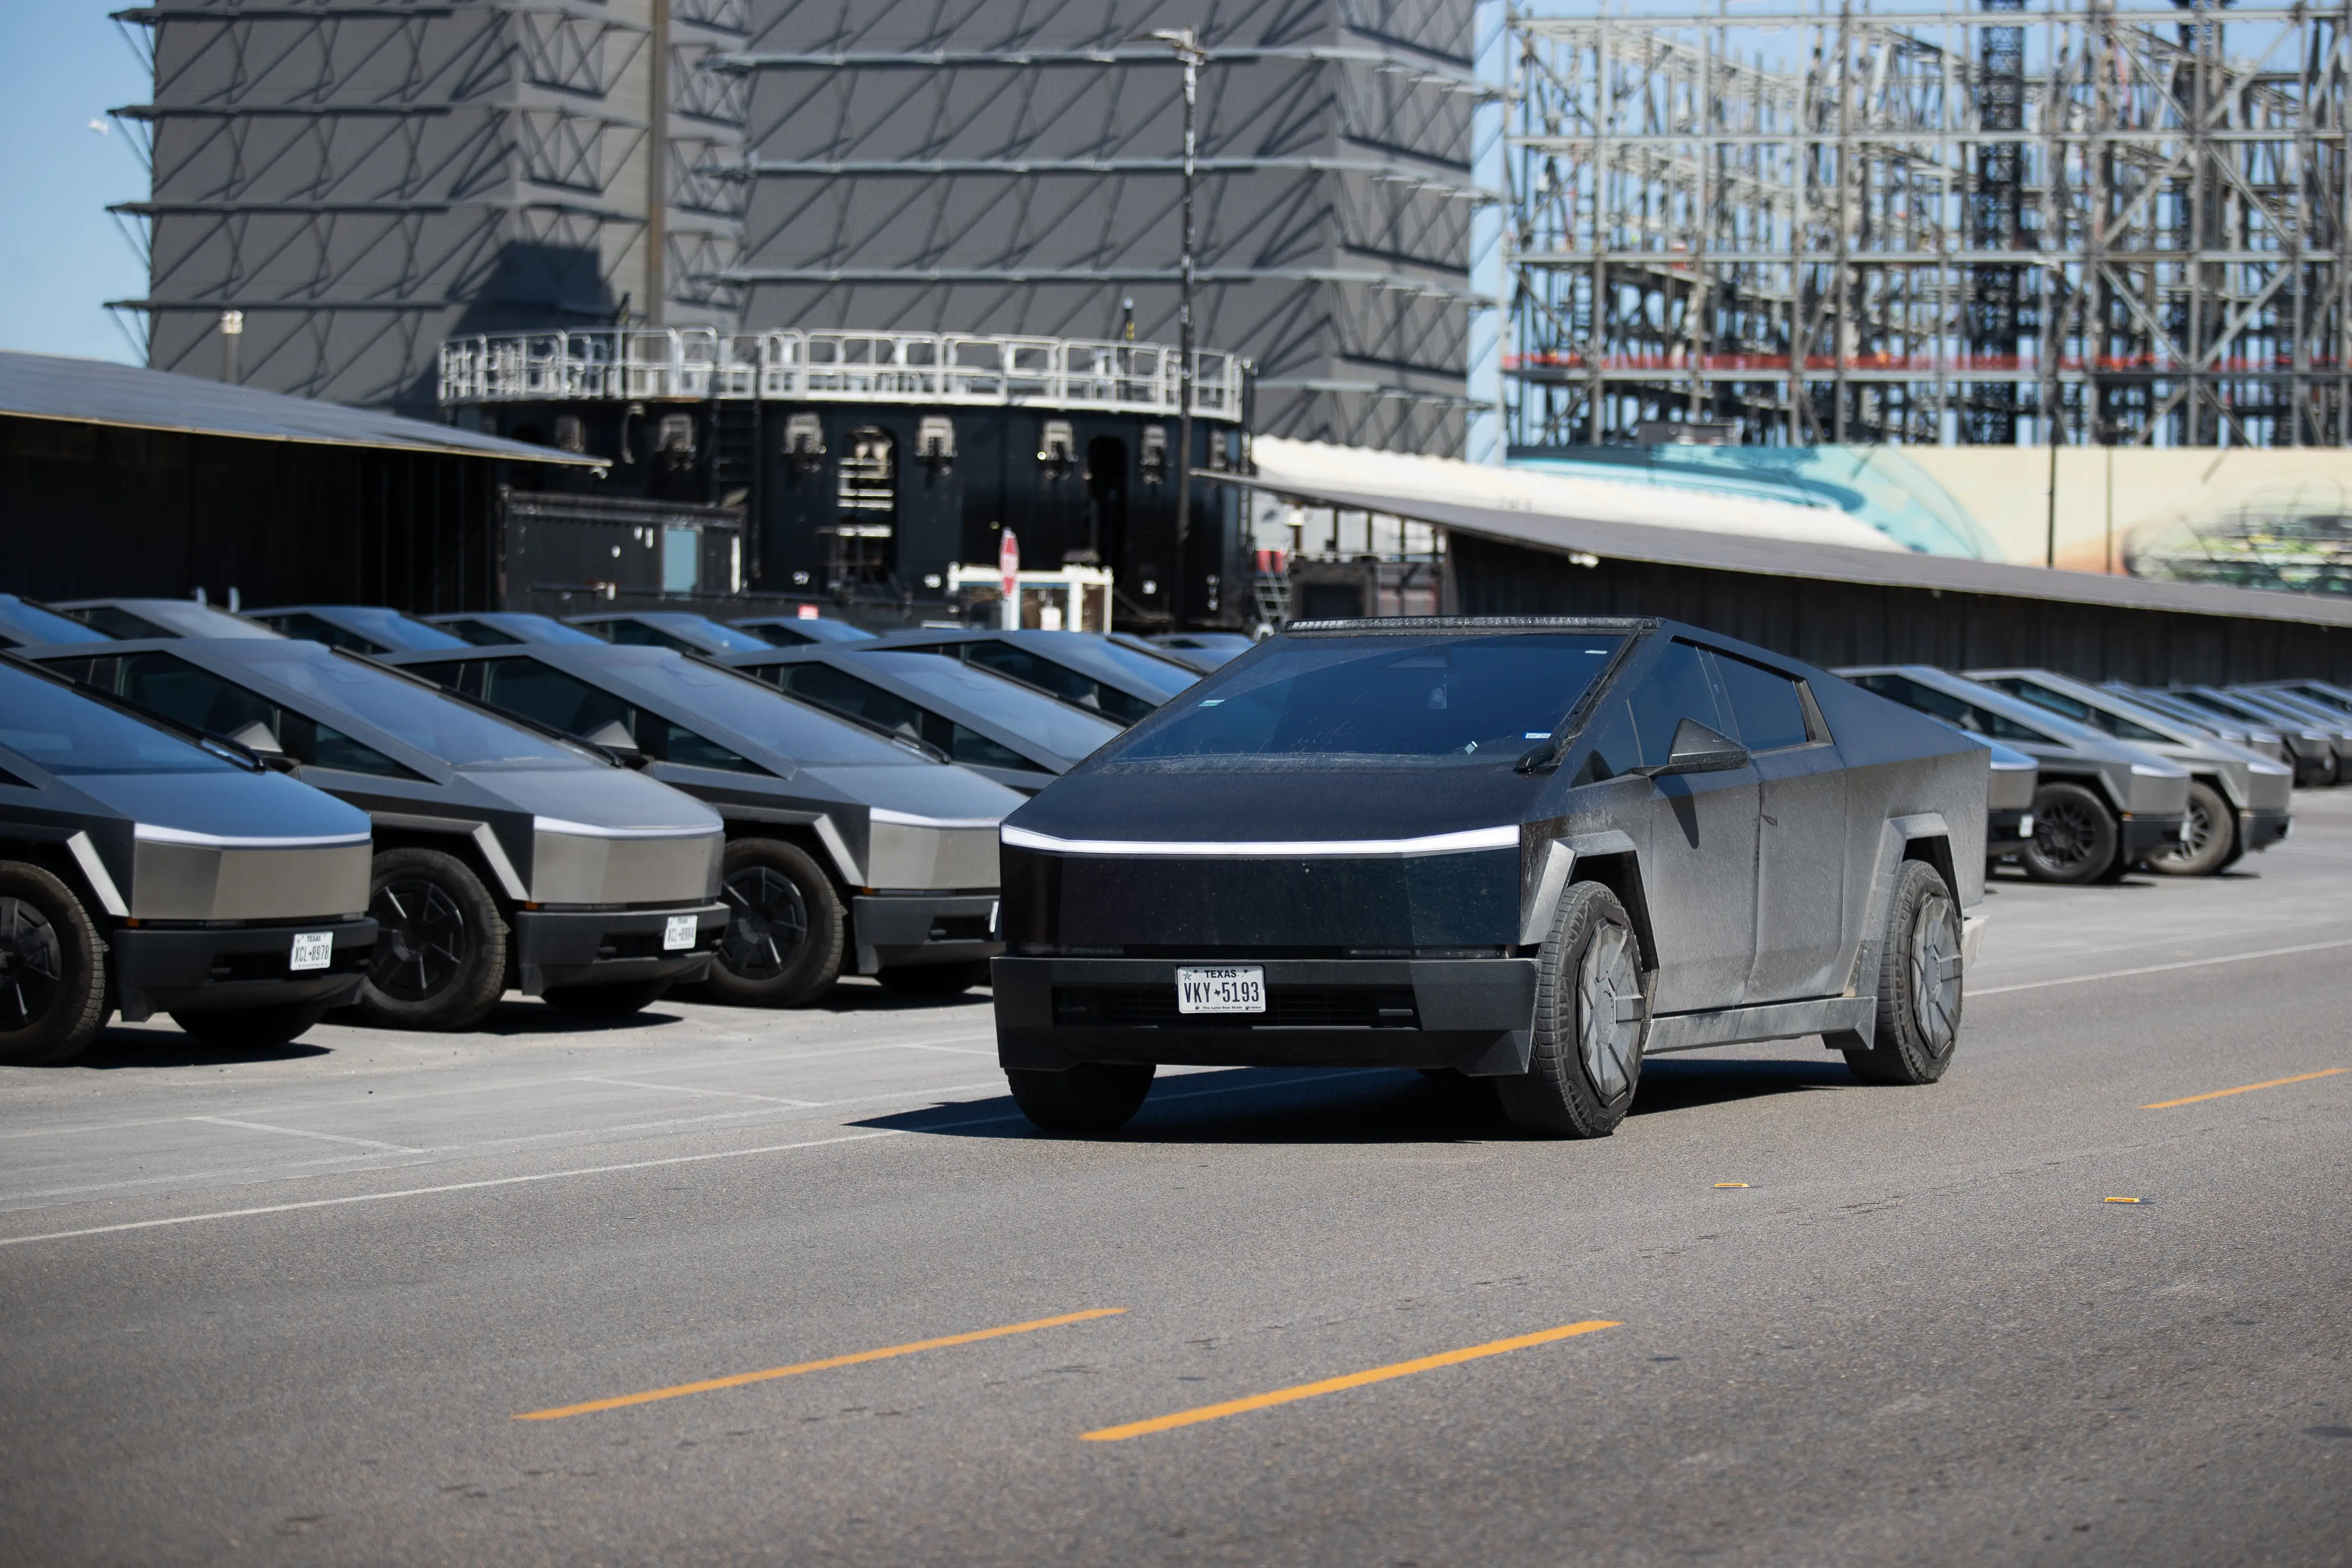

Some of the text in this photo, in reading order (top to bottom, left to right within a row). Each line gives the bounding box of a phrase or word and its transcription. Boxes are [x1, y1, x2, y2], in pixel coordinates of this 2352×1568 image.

[295, 945, 329, 962] XCL 8978
[1204, 969, 1237, 978] TEXAS
[1184, 981, 1259, 1003] VKY 5193
